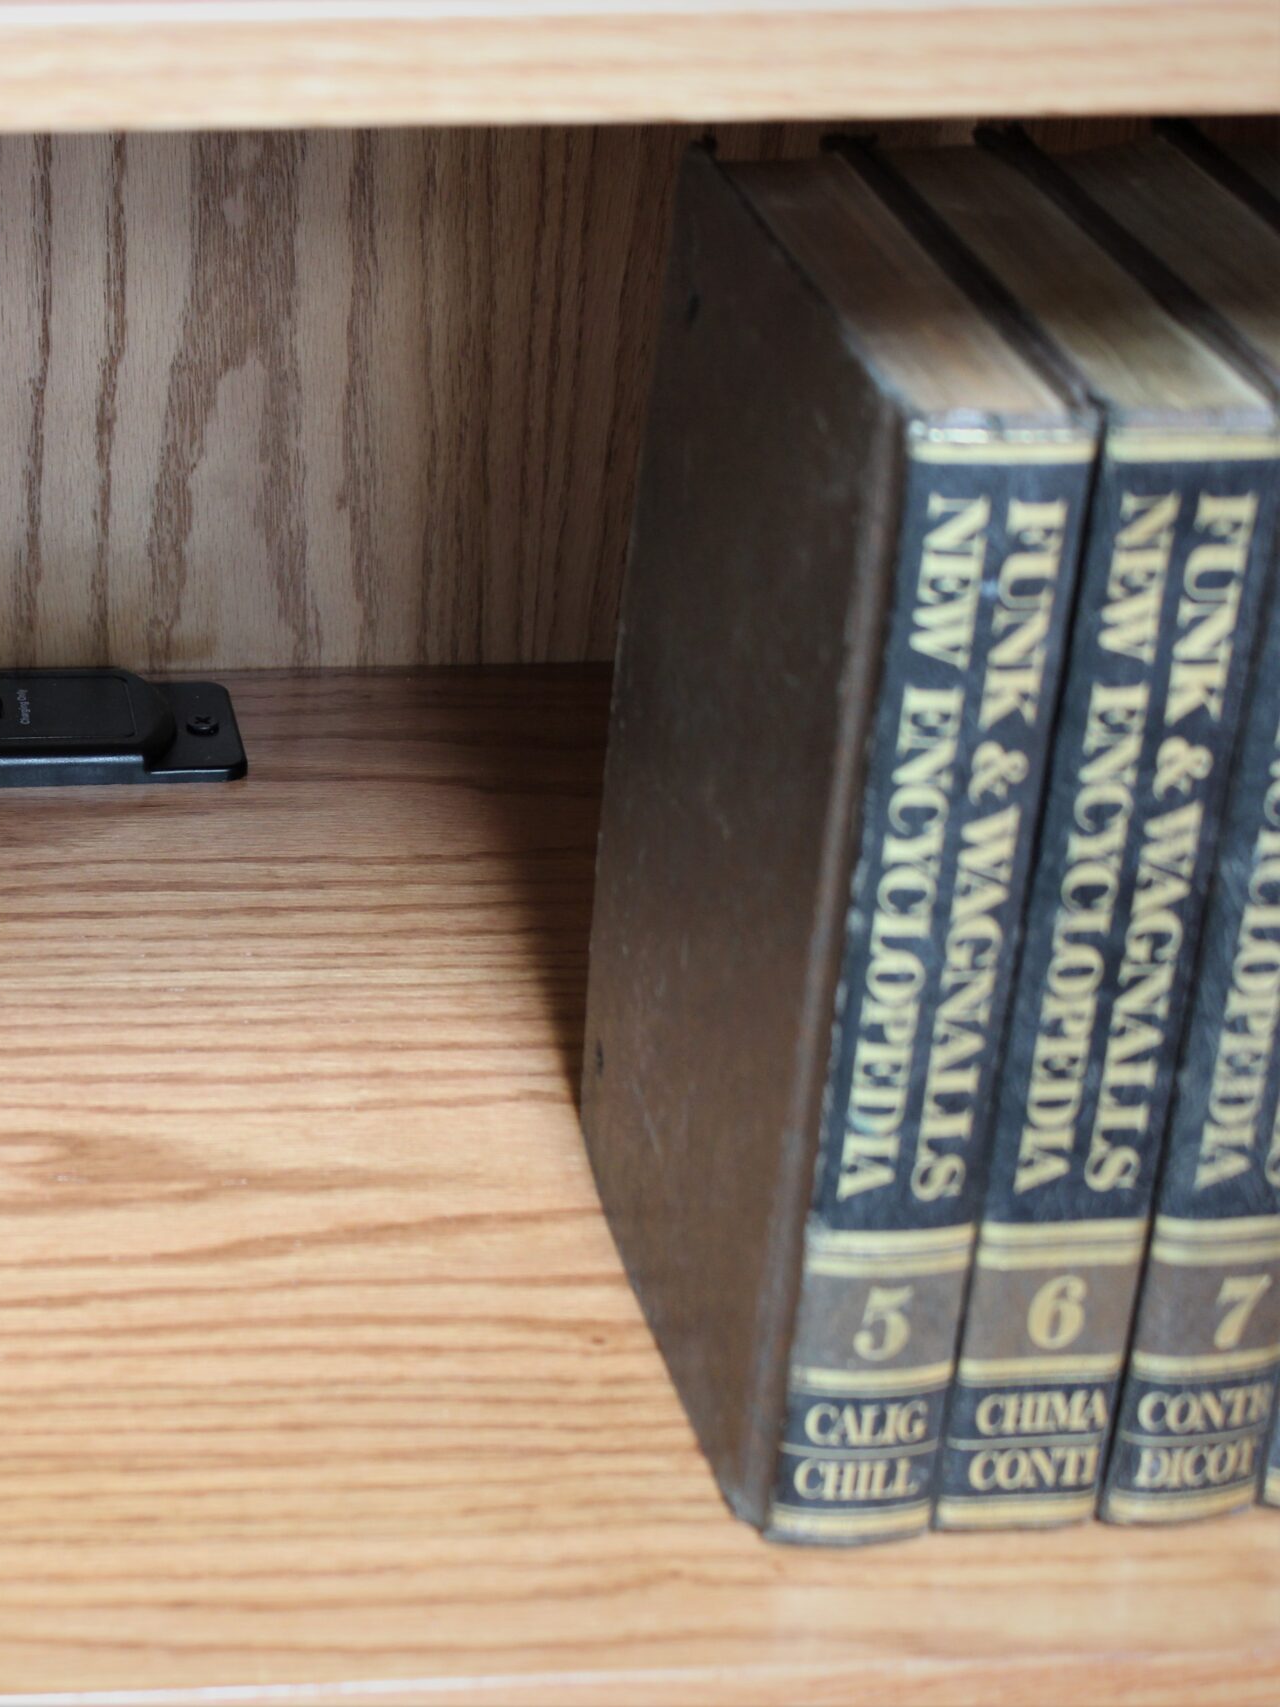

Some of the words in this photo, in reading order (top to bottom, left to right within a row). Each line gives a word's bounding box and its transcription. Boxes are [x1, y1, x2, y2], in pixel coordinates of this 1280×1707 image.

[908, 492, 991, 672] NEW
[979, 497, 1067, 730] FUNK
[1097, 490, 1181, 665] NEW
[1163, 490, 1258, 727] FUNK
[968, 741, 1028, 804] &
[1152, 736, 1213, 801] &
[836, 682, 965, 1201] ENCYCLOPEDIA
[1014, 681, 1150, 1194] ENCYCLOPEDIA
[1084, 801, 1204, 1192] WAGNALLS
[910, 803, 1020, 1201] WAGNALLS
[852, 1285, 914, 1361] 5
[1027, 1274, 1087, 1350] 6
[1214, 1273, 1272, 1349] 7
[804, 1400, 928, 1447] CALIG
[975, 1388, 1108, 1436] CHIMA
[793, 1458, 919, 1500] CHILL
